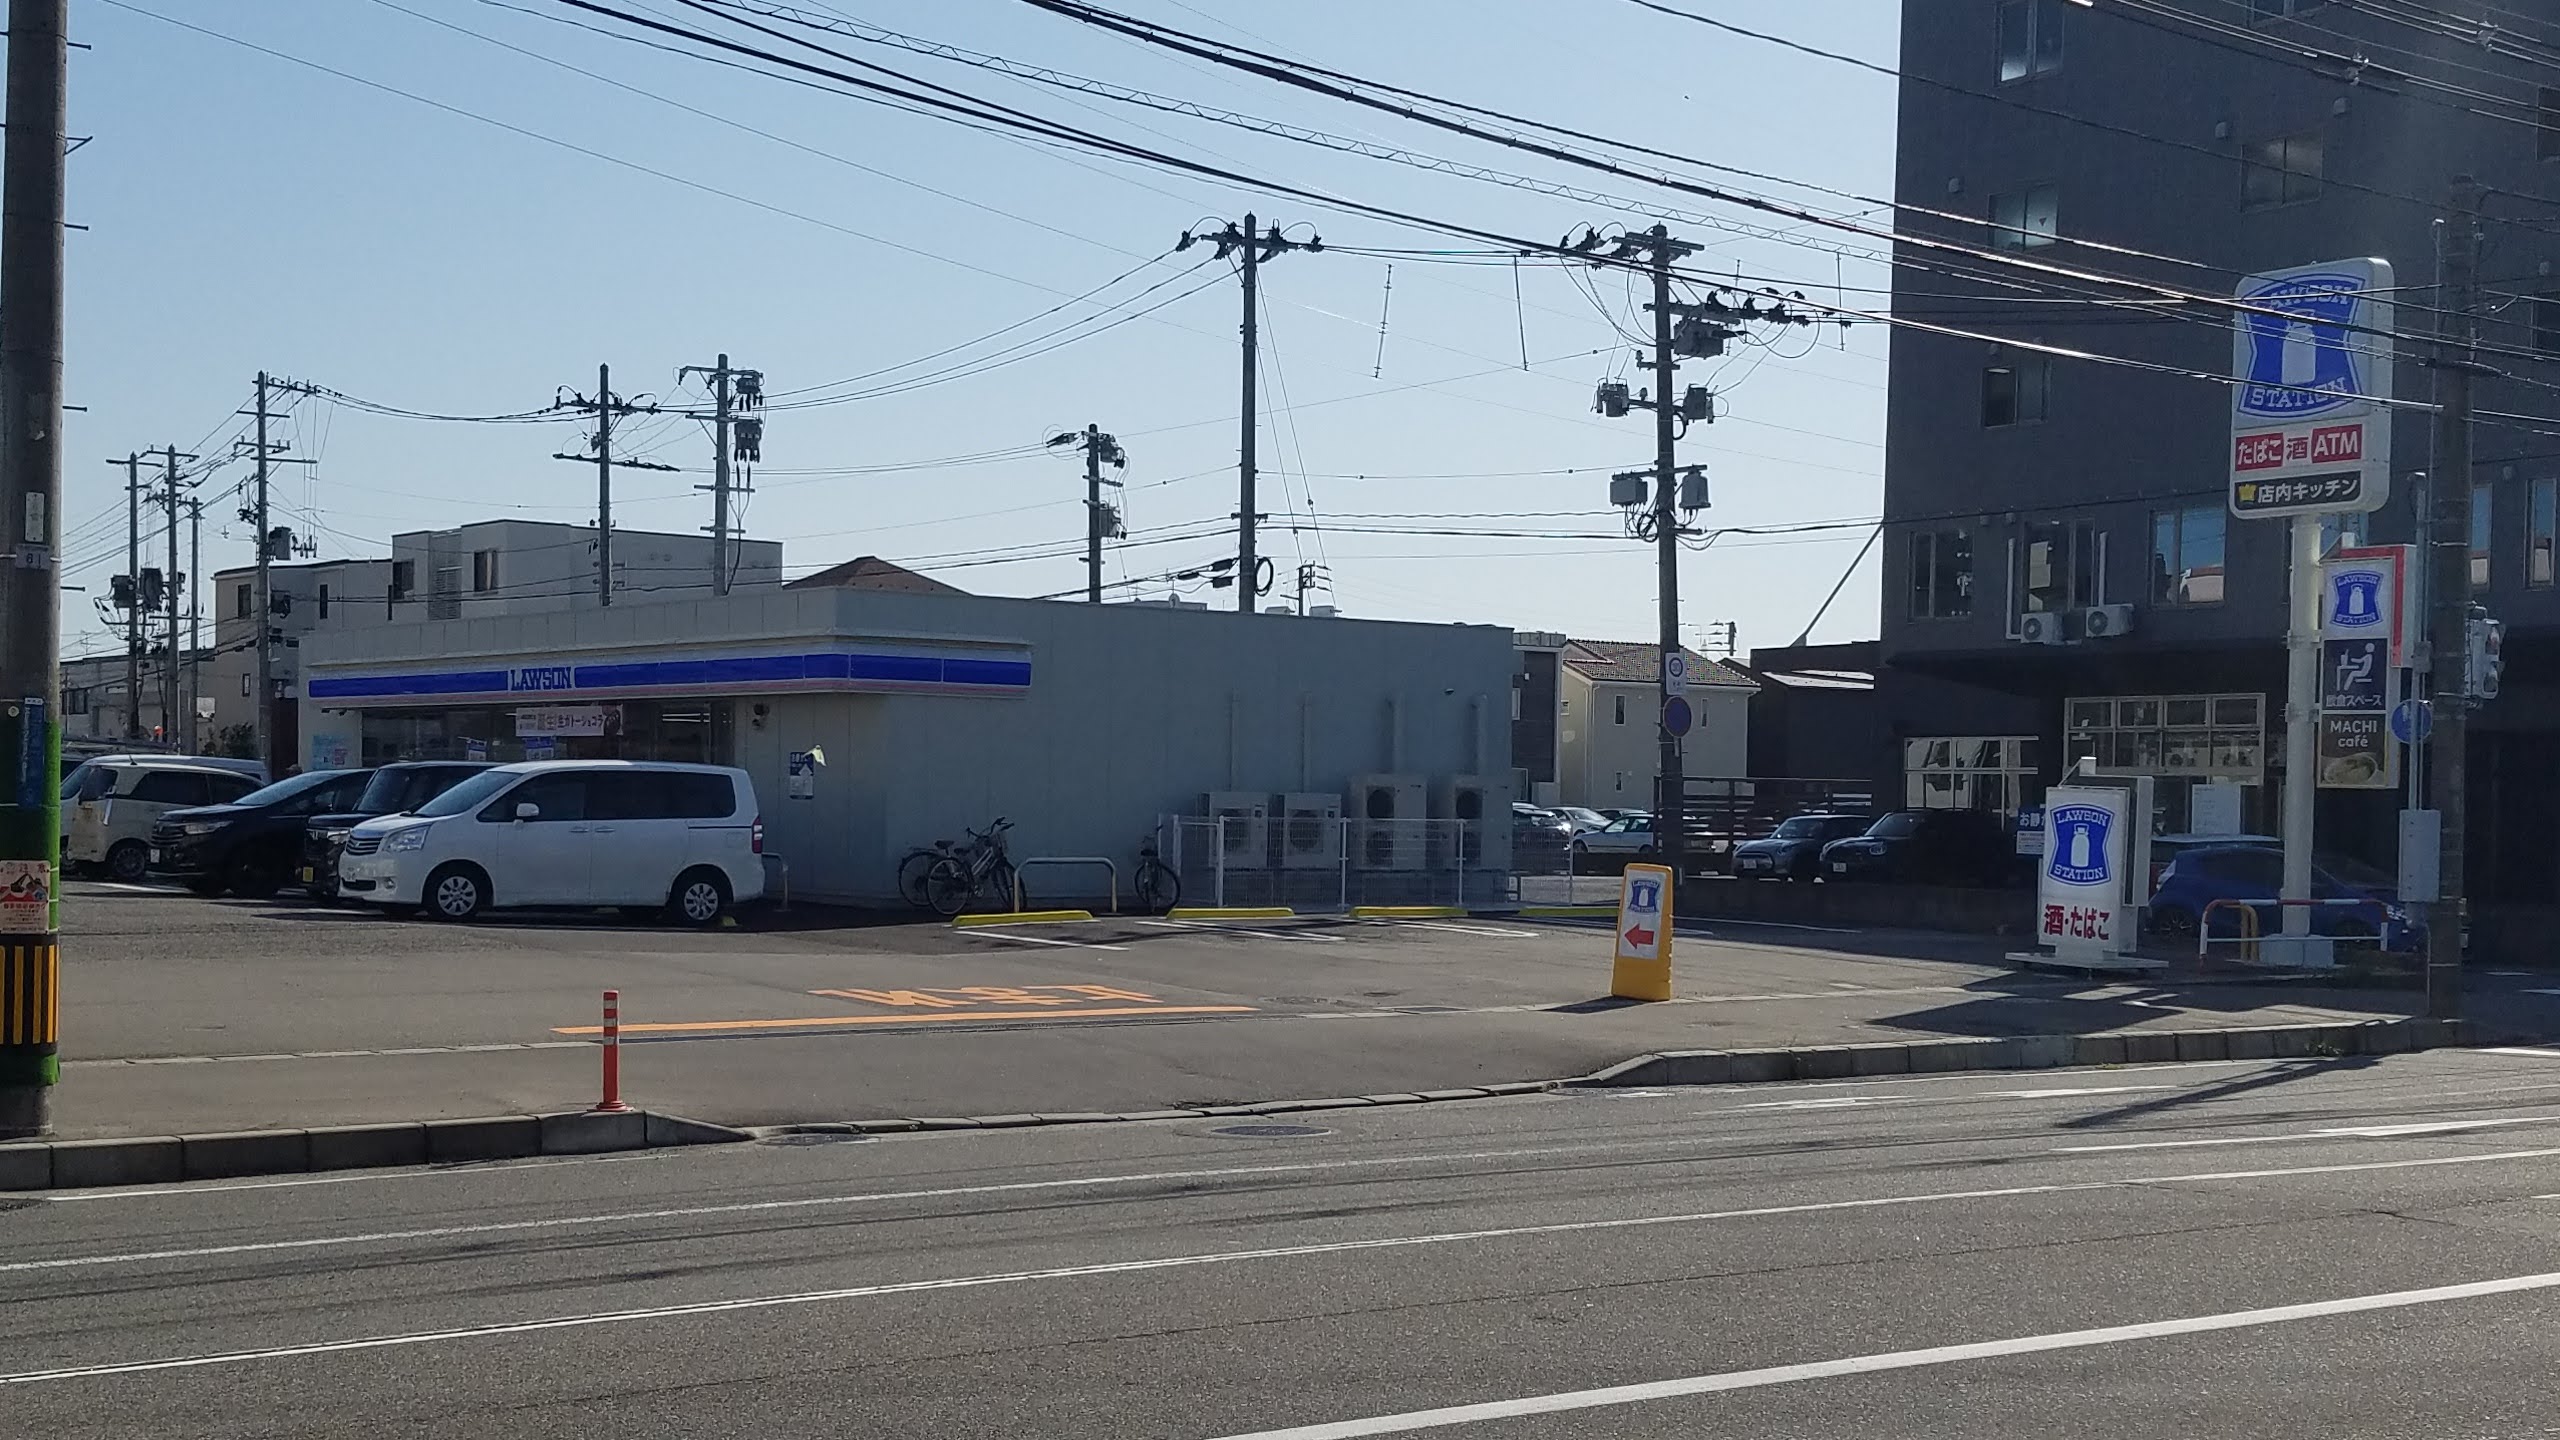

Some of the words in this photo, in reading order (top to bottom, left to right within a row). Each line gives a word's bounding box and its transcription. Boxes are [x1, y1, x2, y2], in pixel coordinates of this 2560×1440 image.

[2250, 376, 2348, 408] STATION
[2237, 438, 2282, 466] たばこ
[2286, 436, 2309, 460] 酒
[2313, 432, 2360, 458] ATM
[2257, 480, 2359, 504] 店内キッチン
[510, 666, 572, 691] LAWSON
[2330, 720, 2378, 733] MACHI
[2337, 735, 2369, 748] café
[2056, 810, 2109, 827] LAWSON
[2053, 863, 2104, 880] STATION
